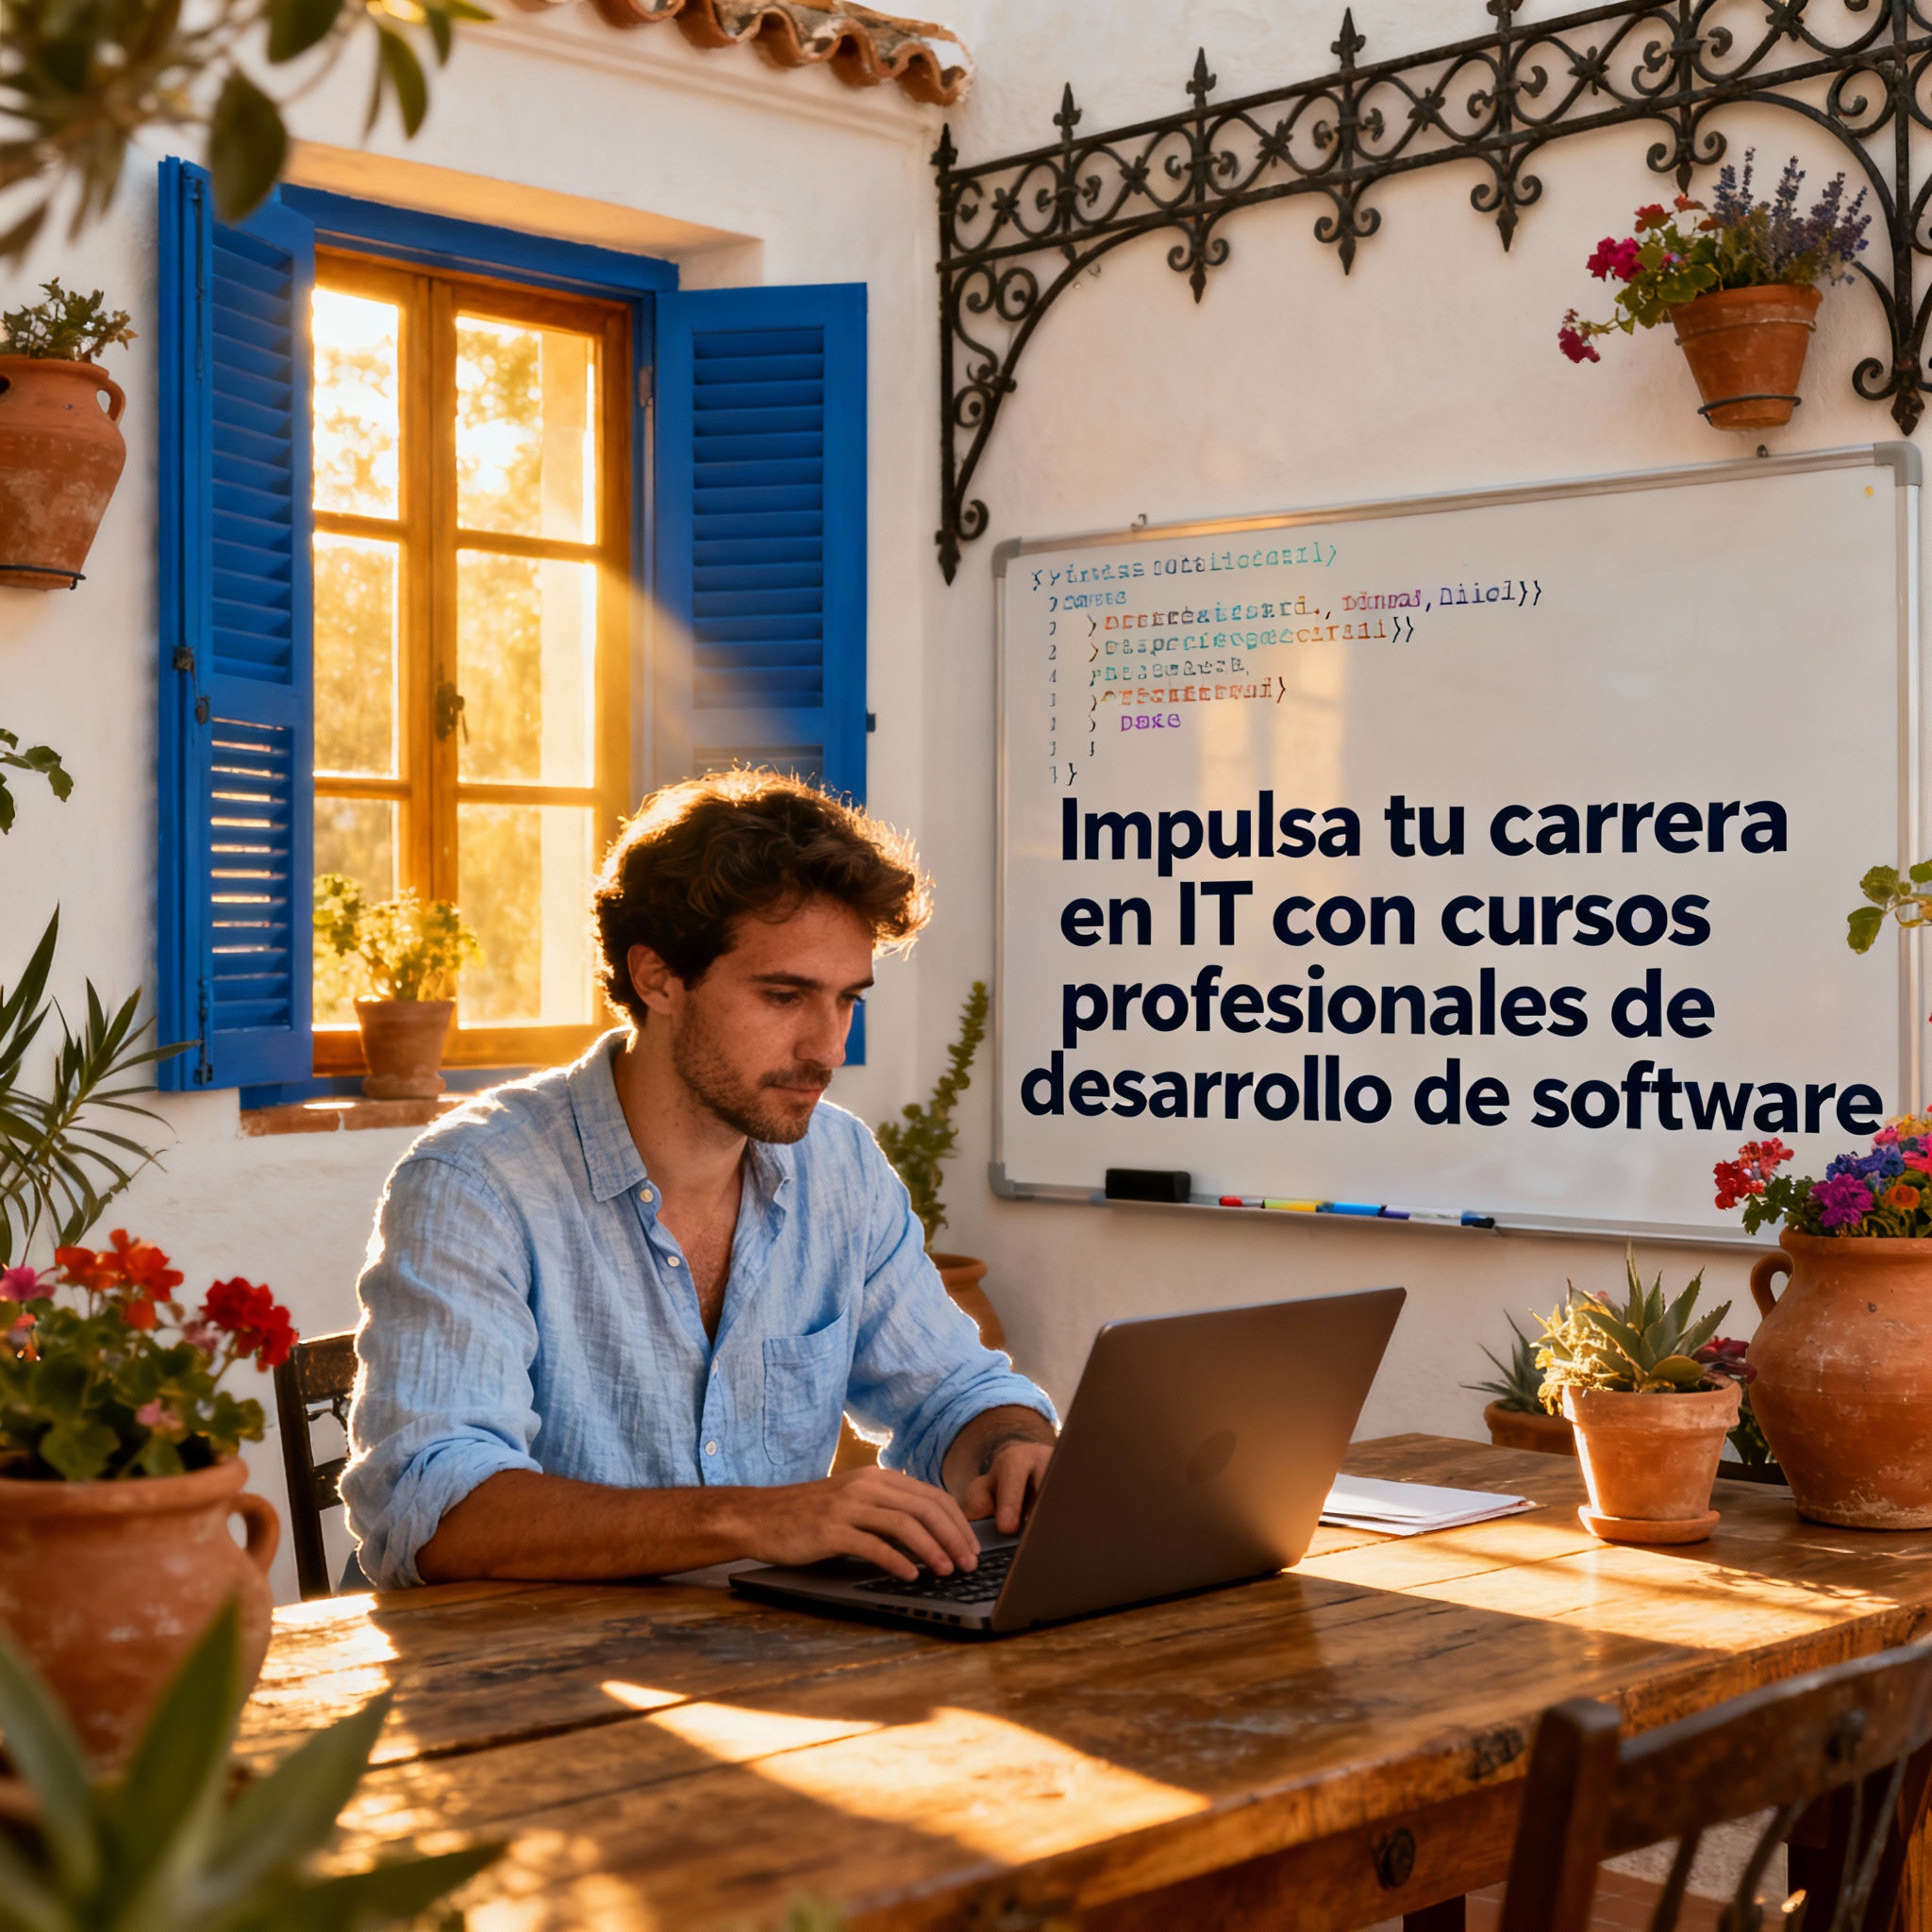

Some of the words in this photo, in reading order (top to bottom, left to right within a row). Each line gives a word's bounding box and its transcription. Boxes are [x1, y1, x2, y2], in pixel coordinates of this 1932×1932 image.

[1062, 790, 1361, 877] Impulsa
[1384, 794, 1465, 858] tu
[1490, 800, 1789, 857] carrera
[1060, 897, 1152, 947] en
[1179, 880, 1254, 946] IT
[1273, 895, 1415, 947] con
[1441, 893, 1711, 947] cursos
[1062, 963, 1589, 1049] profesionales
[1610, 967, 1715, 1039] de
[1020, 1050, 1392, 1124] desarrollo
[1413, 1058, 1510, 1126] de
[1530, 1059, 1884, 1136] software
